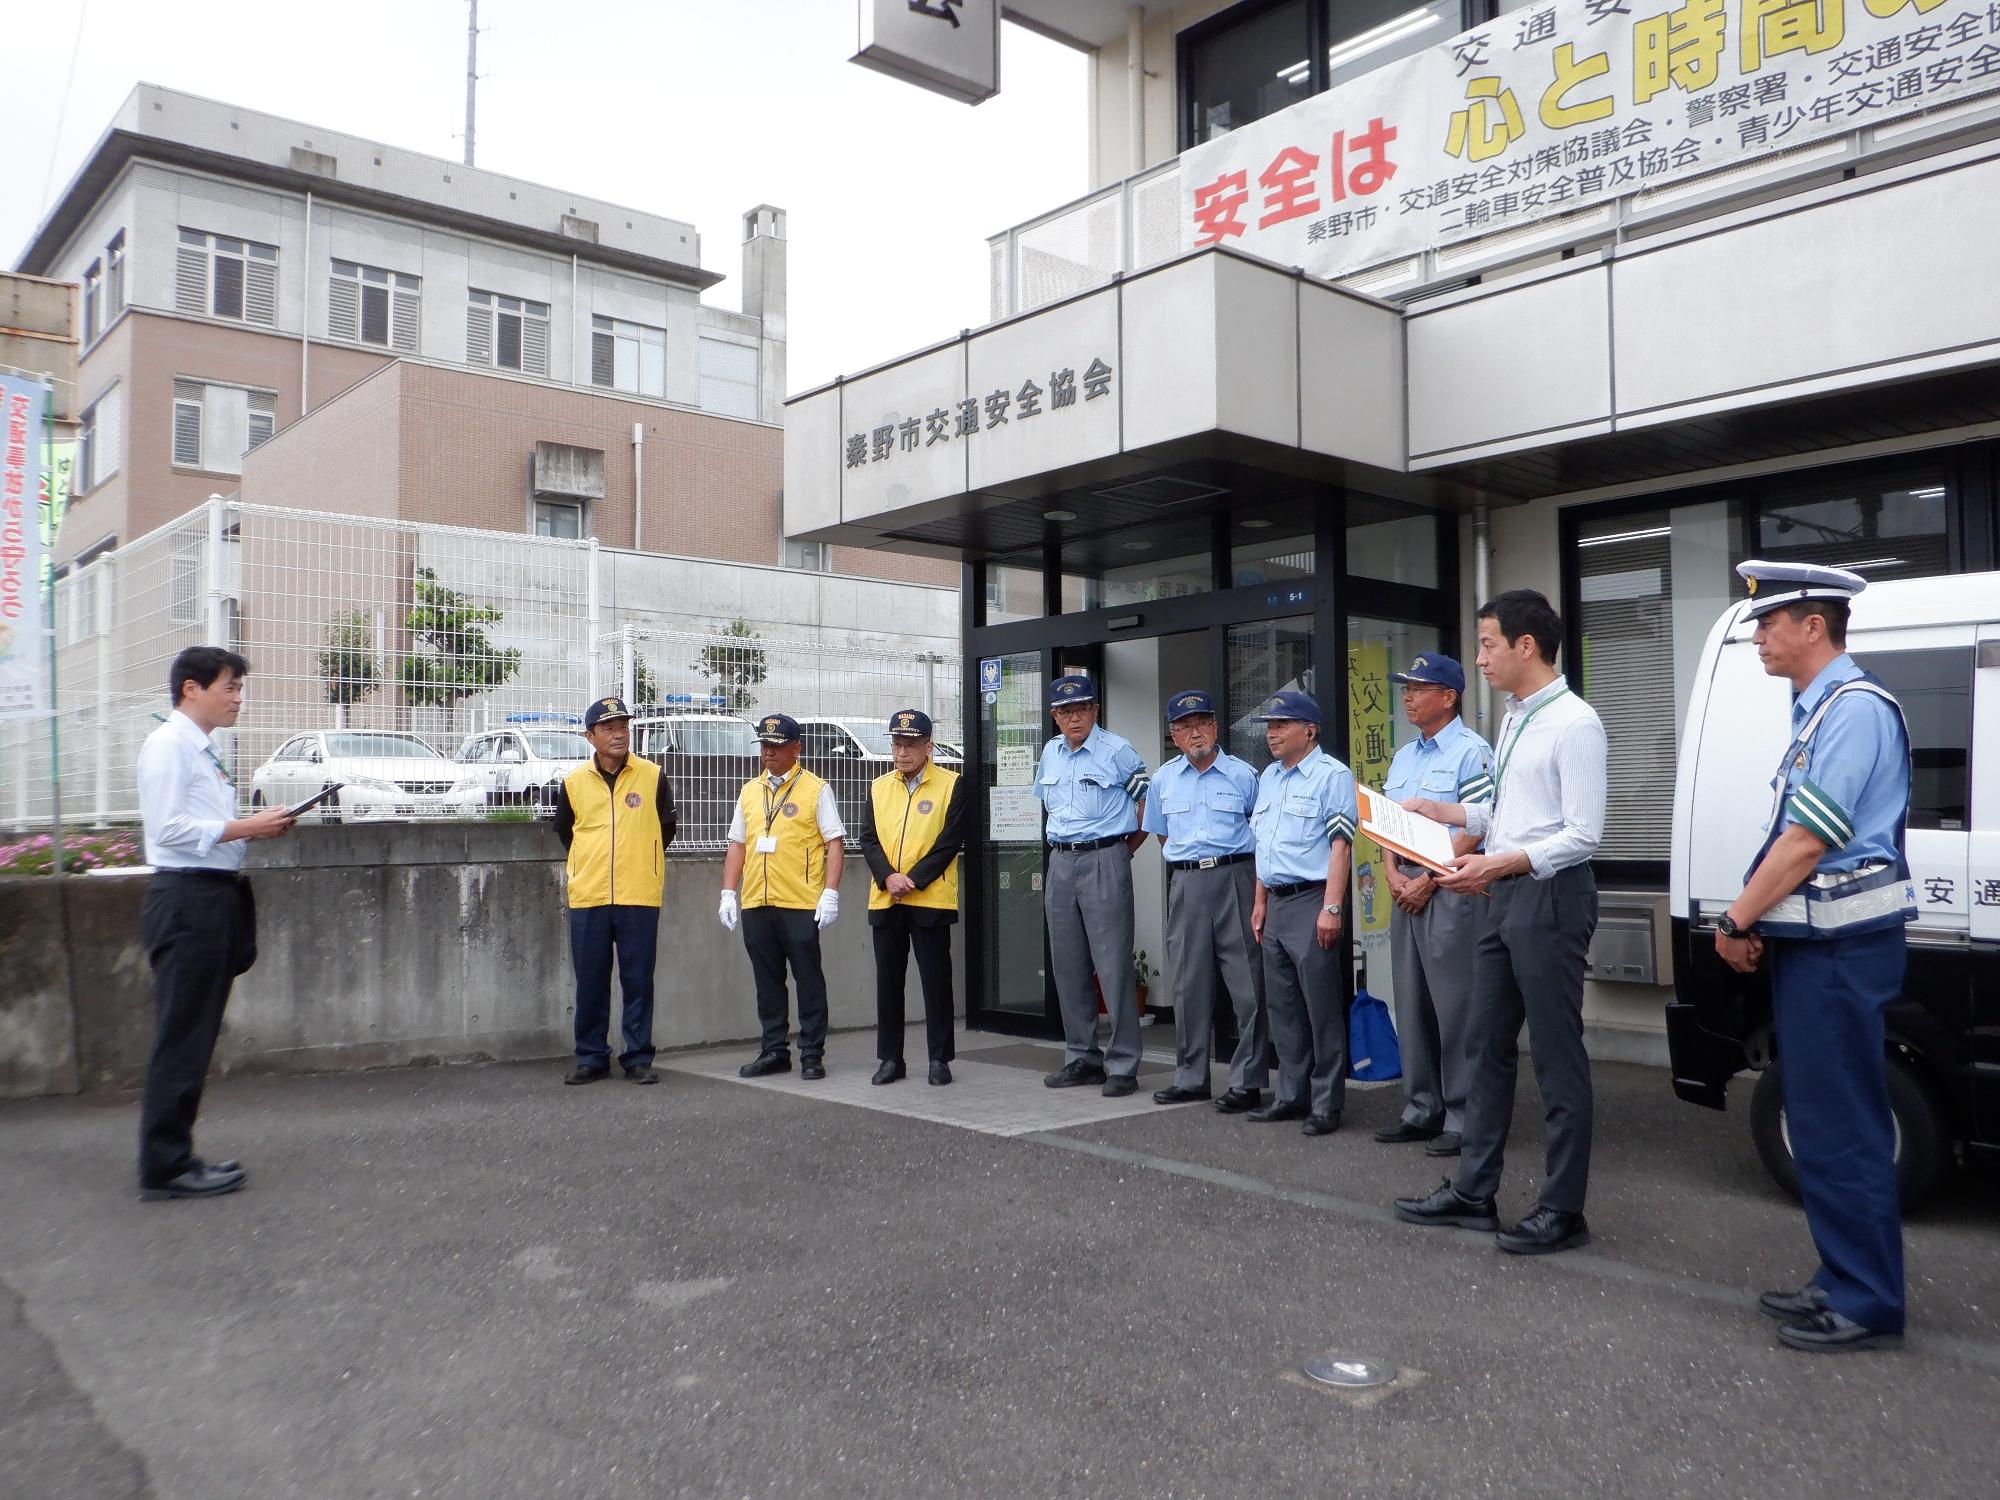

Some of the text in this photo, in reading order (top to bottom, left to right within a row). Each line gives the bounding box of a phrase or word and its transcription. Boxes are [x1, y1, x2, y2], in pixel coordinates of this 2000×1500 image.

[1193, 116, 1398, 247] 安全は
[845, 357, 1114, 470] 秦野市交通安全協会
